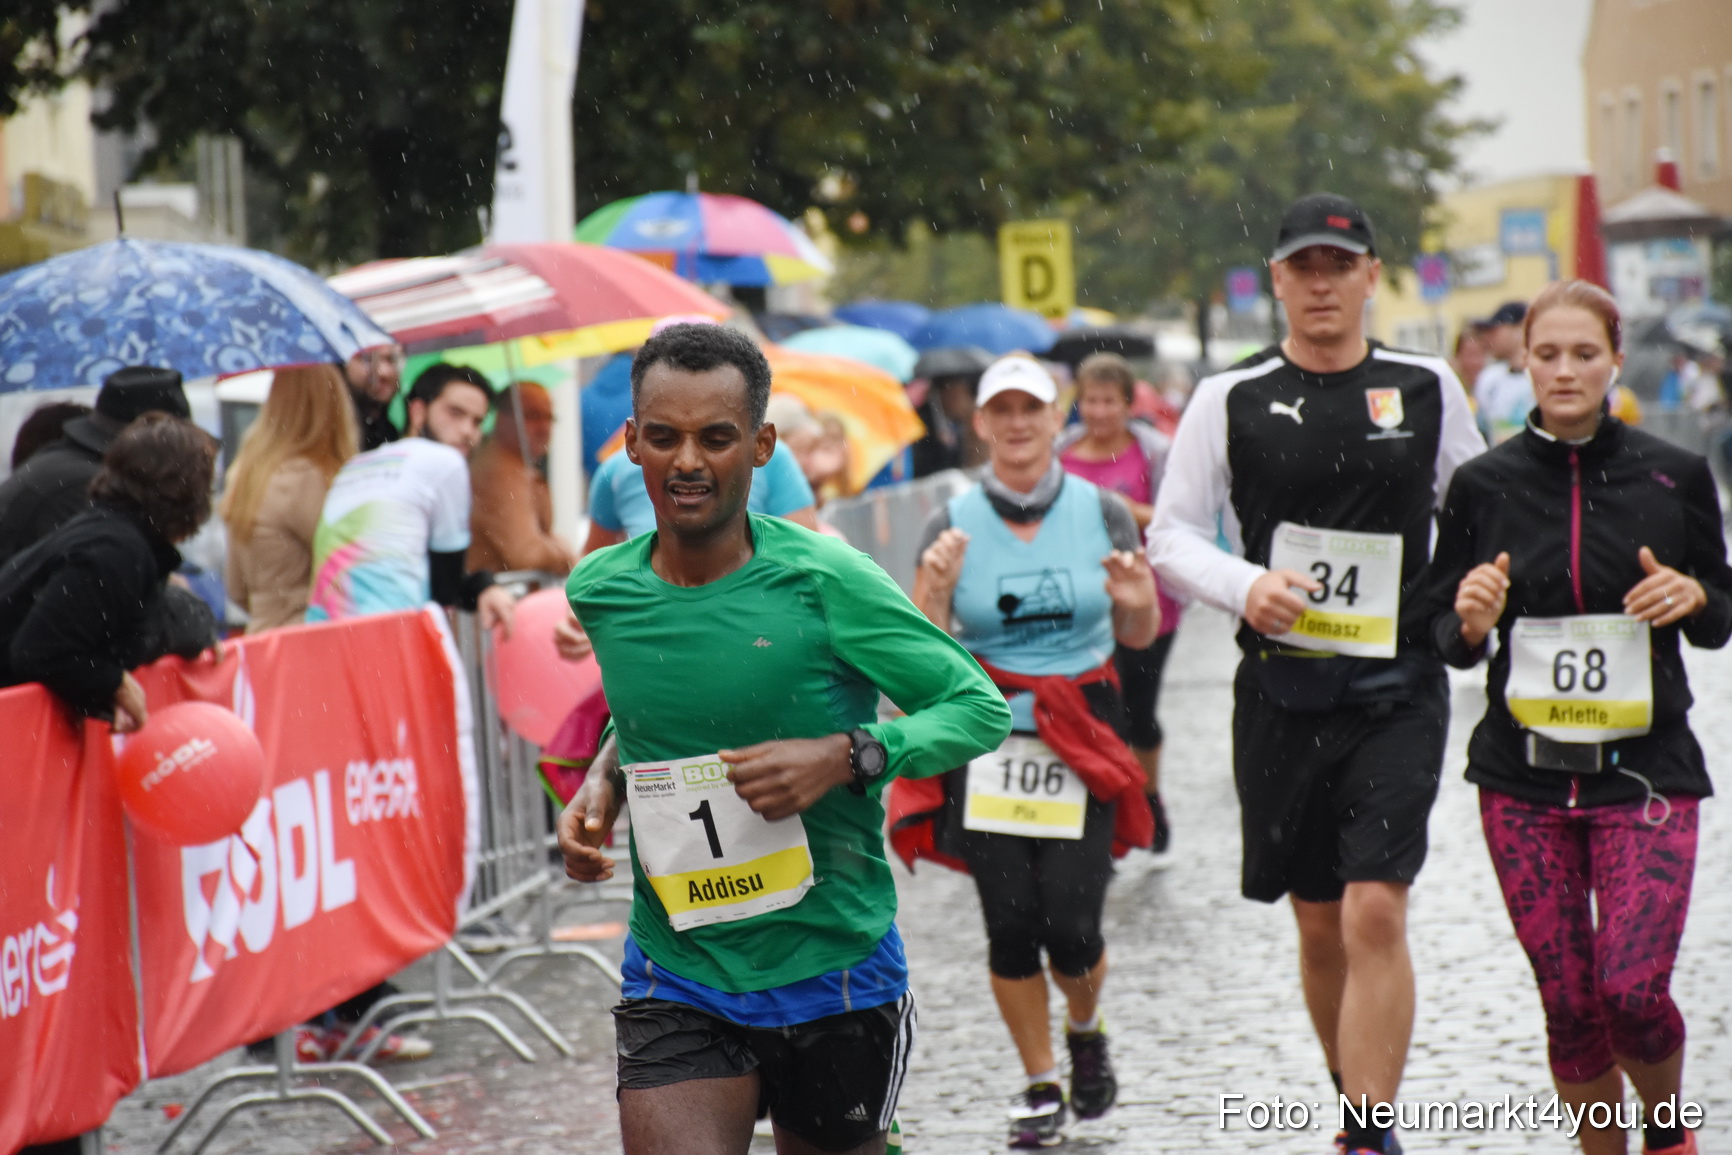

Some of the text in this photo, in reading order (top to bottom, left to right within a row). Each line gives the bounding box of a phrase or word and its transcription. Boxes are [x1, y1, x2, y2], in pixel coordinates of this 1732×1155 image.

[1020, 254, 1055, 302] D
[1308, 561, 1360, 606] 34
[1299, 613, 1362, 638] Tomasz
[1553, 647, 1608, 693] 68
[1549, 706, 1609, 725] Arlette
[635, 782, 676, 793] NeuerMarkt
[998, 757, 1066, 796] 106
[689, 800, 724, 859] 1
[688, 873, 764, 904] Addisu
